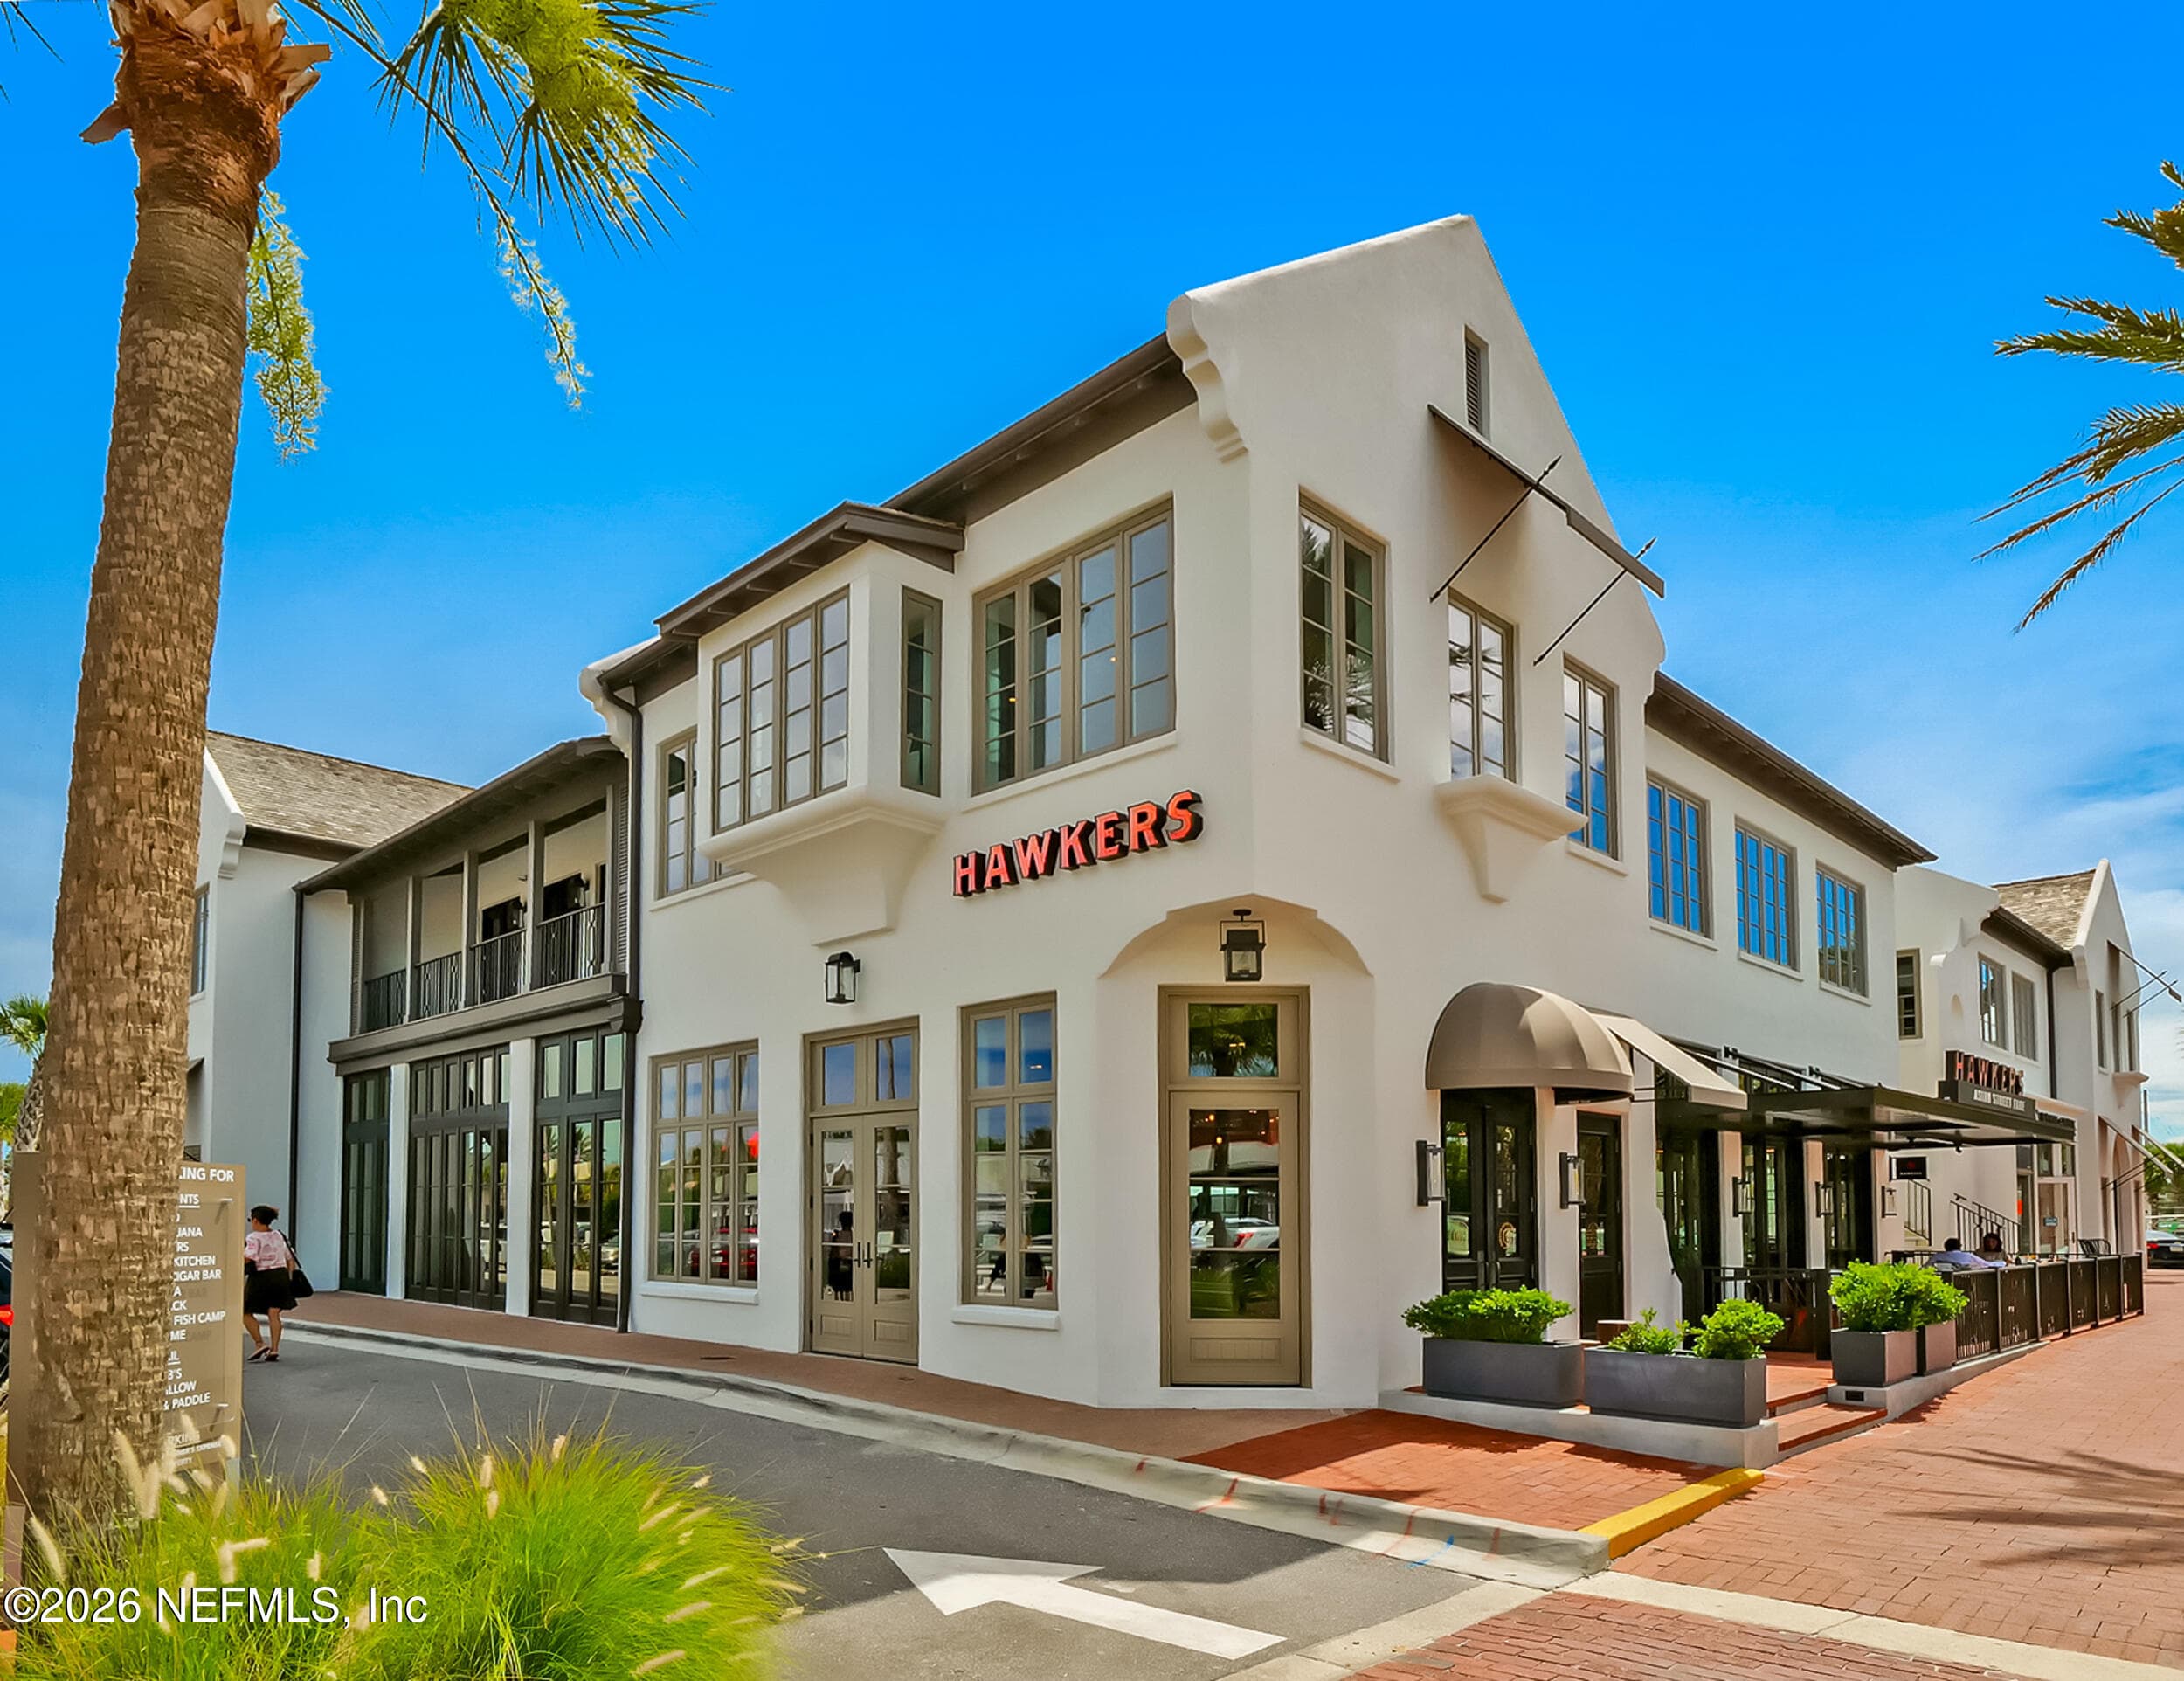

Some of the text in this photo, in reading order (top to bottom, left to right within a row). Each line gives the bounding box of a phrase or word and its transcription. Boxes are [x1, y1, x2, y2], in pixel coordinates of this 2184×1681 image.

[953, 789, 1203, 897] HAWKERS
[1948, 1050, 2024, 1097] HAWKERS
[179, 1166, 234, 1182] ING FOR
[202, 1269, 222, 1280] BAR
[171, 1300, 187, 1311] CK
[174, 1311, 225, 1325] FISH CAMP
[172, 1392, 211, 1409] PADDLE
